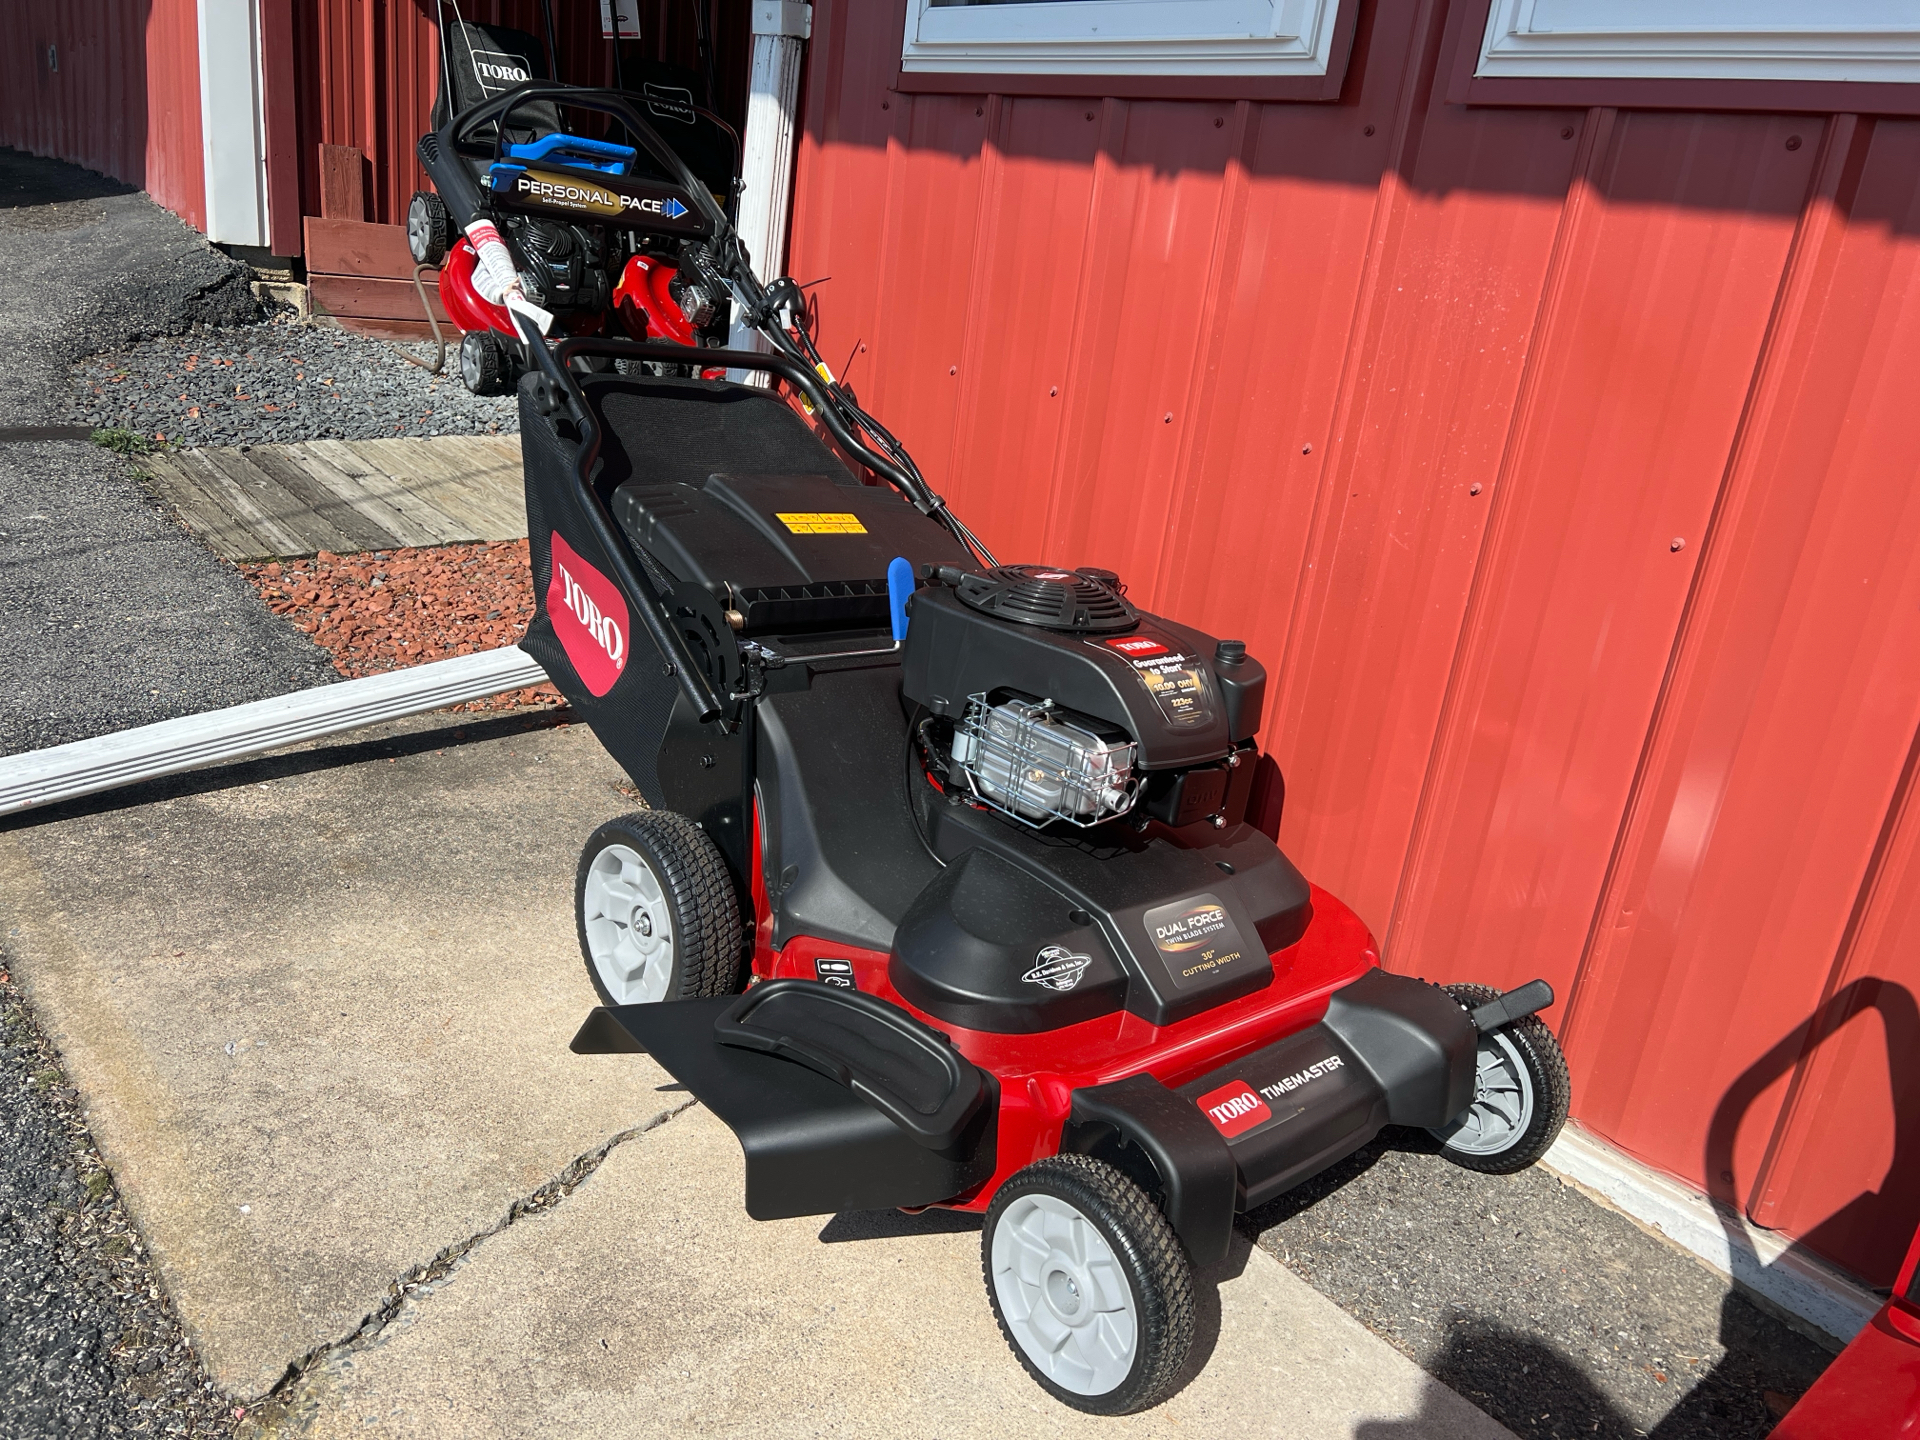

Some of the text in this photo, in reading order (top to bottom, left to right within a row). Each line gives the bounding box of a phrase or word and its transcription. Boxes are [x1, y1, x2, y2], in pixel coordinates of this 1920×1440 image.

[517, 179, 662, 214] PERSONAL PACE
[569, 201, 587, 209] System
[558, 562, 623, 662] TORO
[1132, 653, 1185, 668] Guaranteed
[1149, 667, 1160, 675] to
[1153, 681, 1175, 692] 10.00
[1177, 679, 1193, 689] OHV
[1171, 697, 1193, 707] 223cc
[1156, 909, 1224, 939] DUAL FORCE
[1165, 922, 1226, 946] TWIN BLADE SYSTEM
[1182, 951, 1241, 977] CUTTING WIDTH
[1208, 1055, 1345, 1125] TORO TIMEMASTER
